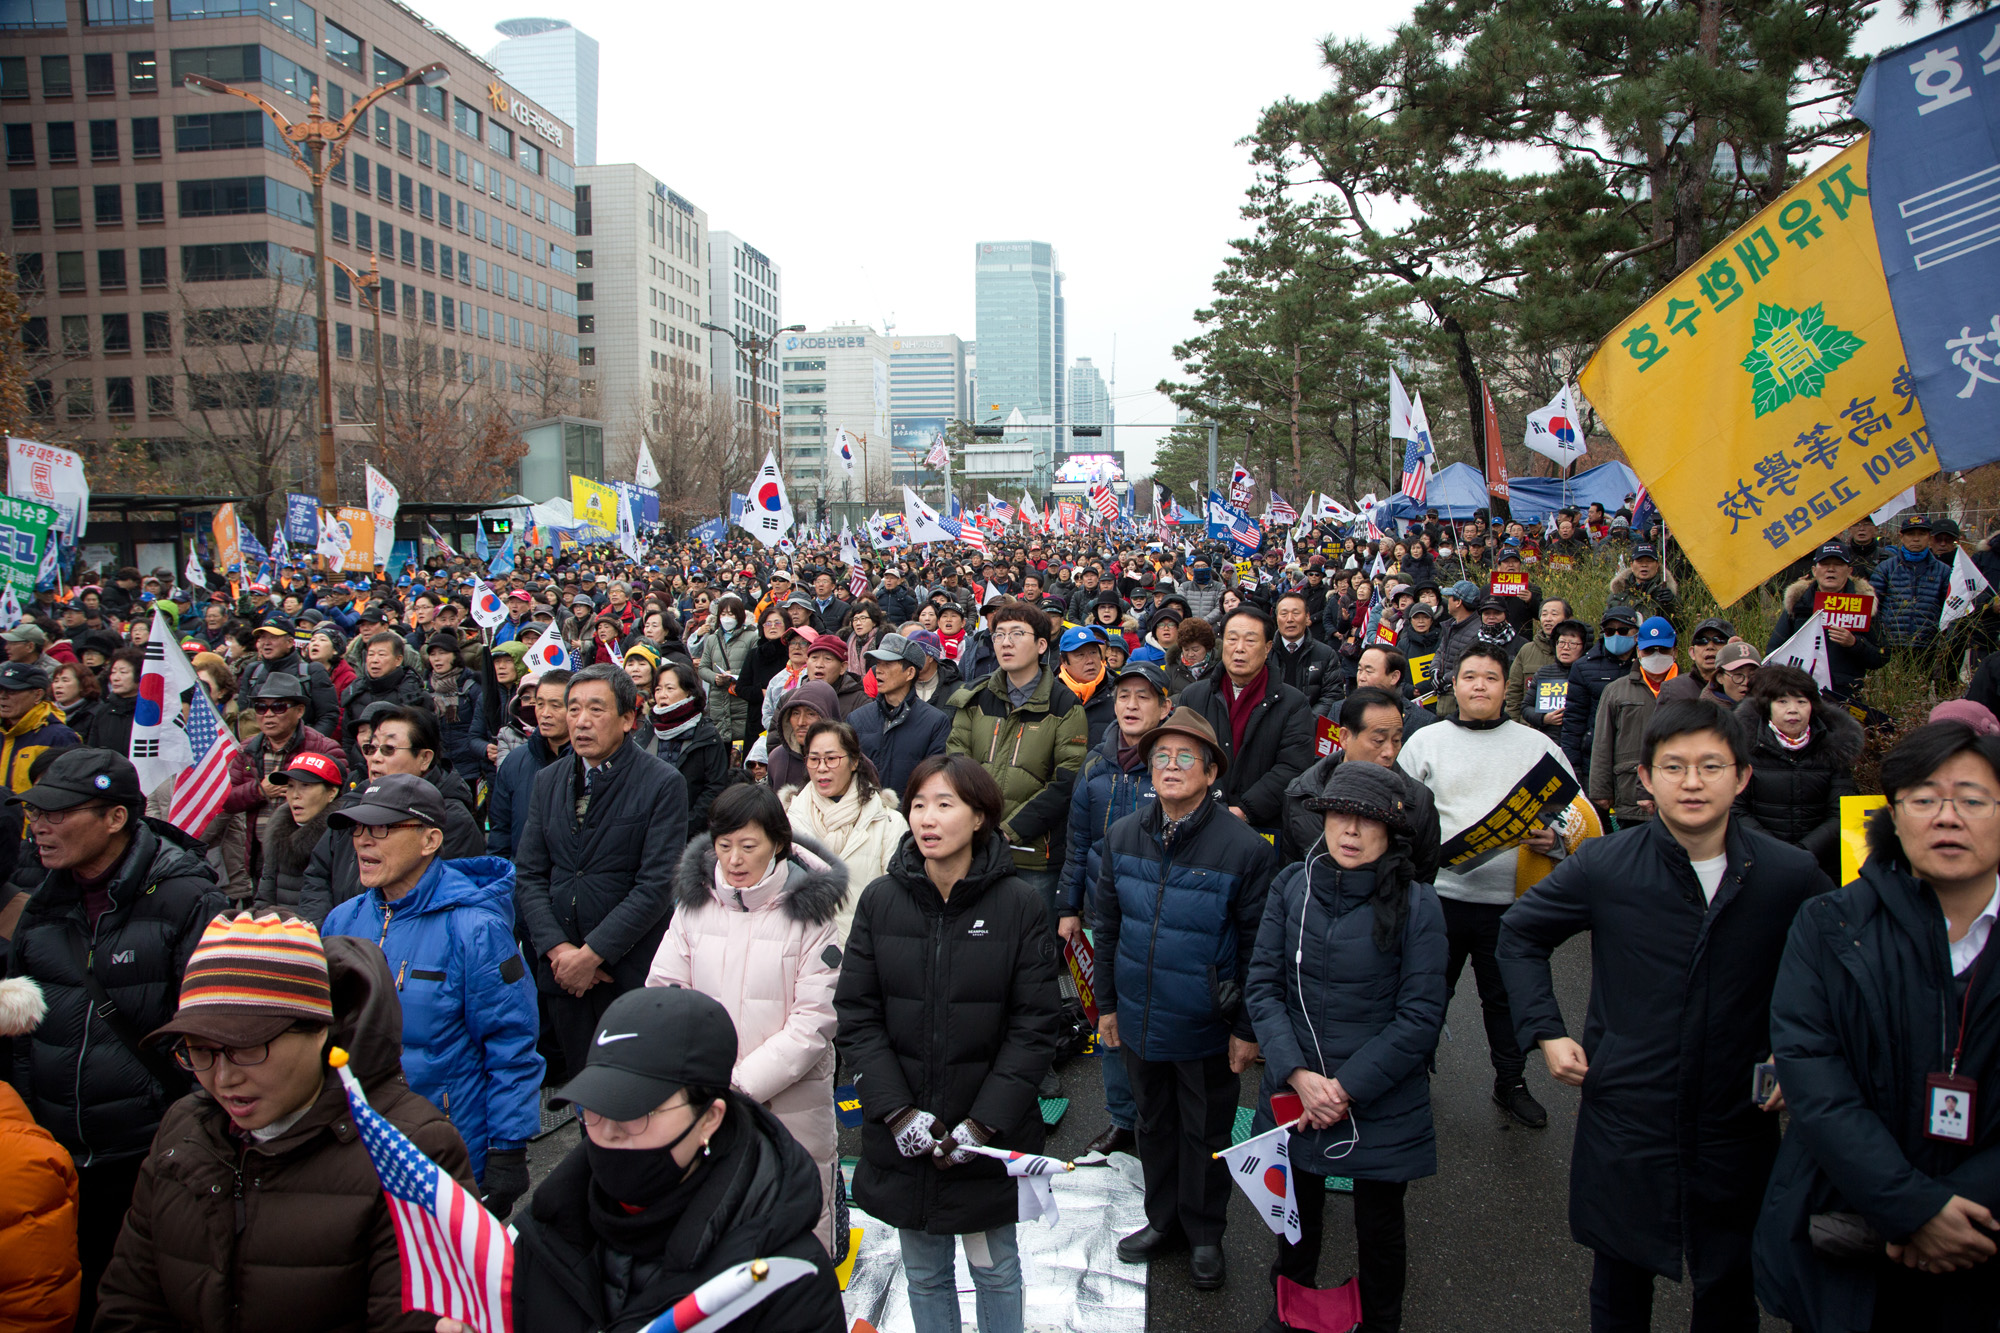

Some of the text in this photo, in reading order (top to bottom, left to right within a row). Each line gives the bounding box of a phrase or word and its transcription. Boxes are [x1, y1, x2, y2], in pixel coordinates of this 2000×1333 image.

[511, 97, 563, 148] KB국민은행
[801, 336, 865, 349] KDB산업은행
[17, 443, 73, 468] 자유대한수호
[1497, 573, 1522, 584] 선거법
[1492, 583, 1526, 595] 결사반대
[1823, 595, 1863, 612] 선거법
[1737, 644, 1751, 658] B
[305, 756, 326, 769] 반대
[1449, 776, 1562, 865] 비례대표제
[1464, 786, 1532, 845] 연동형
